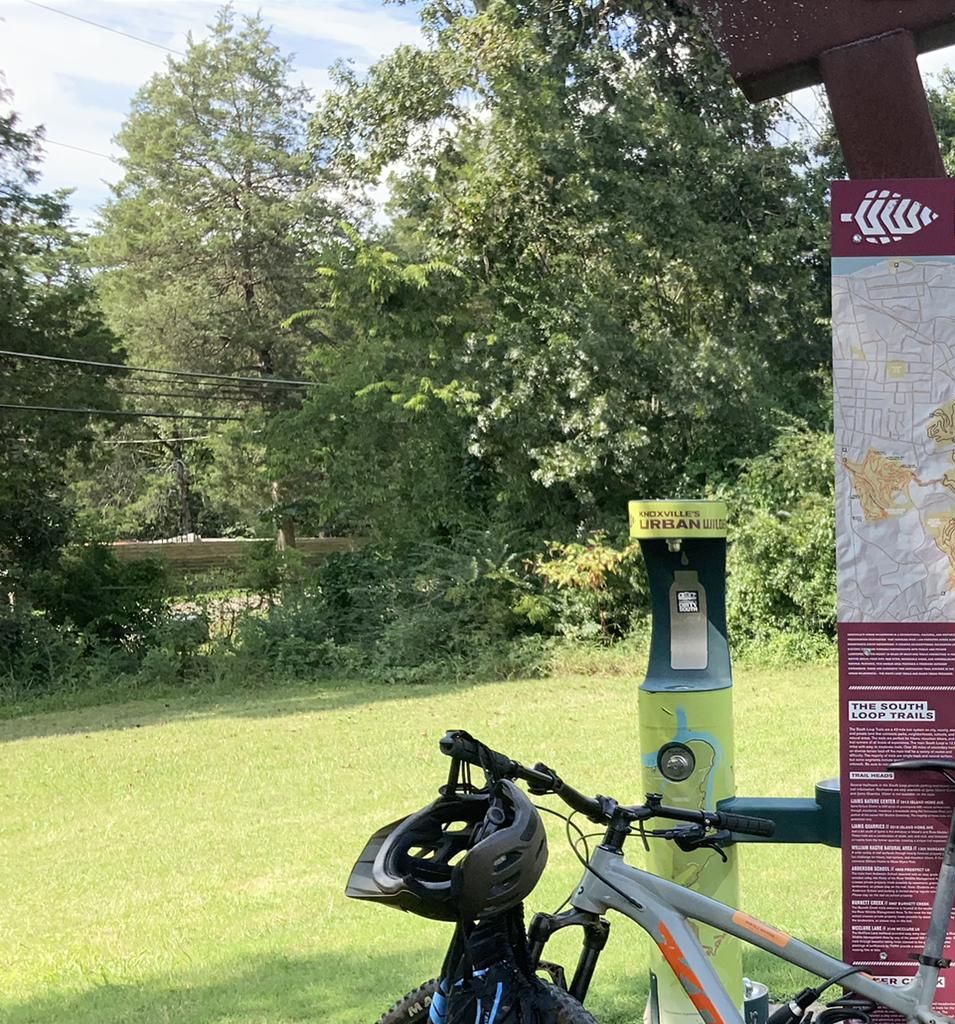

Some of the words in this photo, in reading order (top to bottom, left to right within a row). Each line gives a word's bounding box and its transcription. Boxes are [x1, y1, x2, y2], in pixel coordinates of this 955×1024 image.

[640, 519, 701, 529] URBAN
[851, 702, 876, 710] THE
[880, 702, 924, 710] SOUTH
[408, 995, 432, 1018] MA
